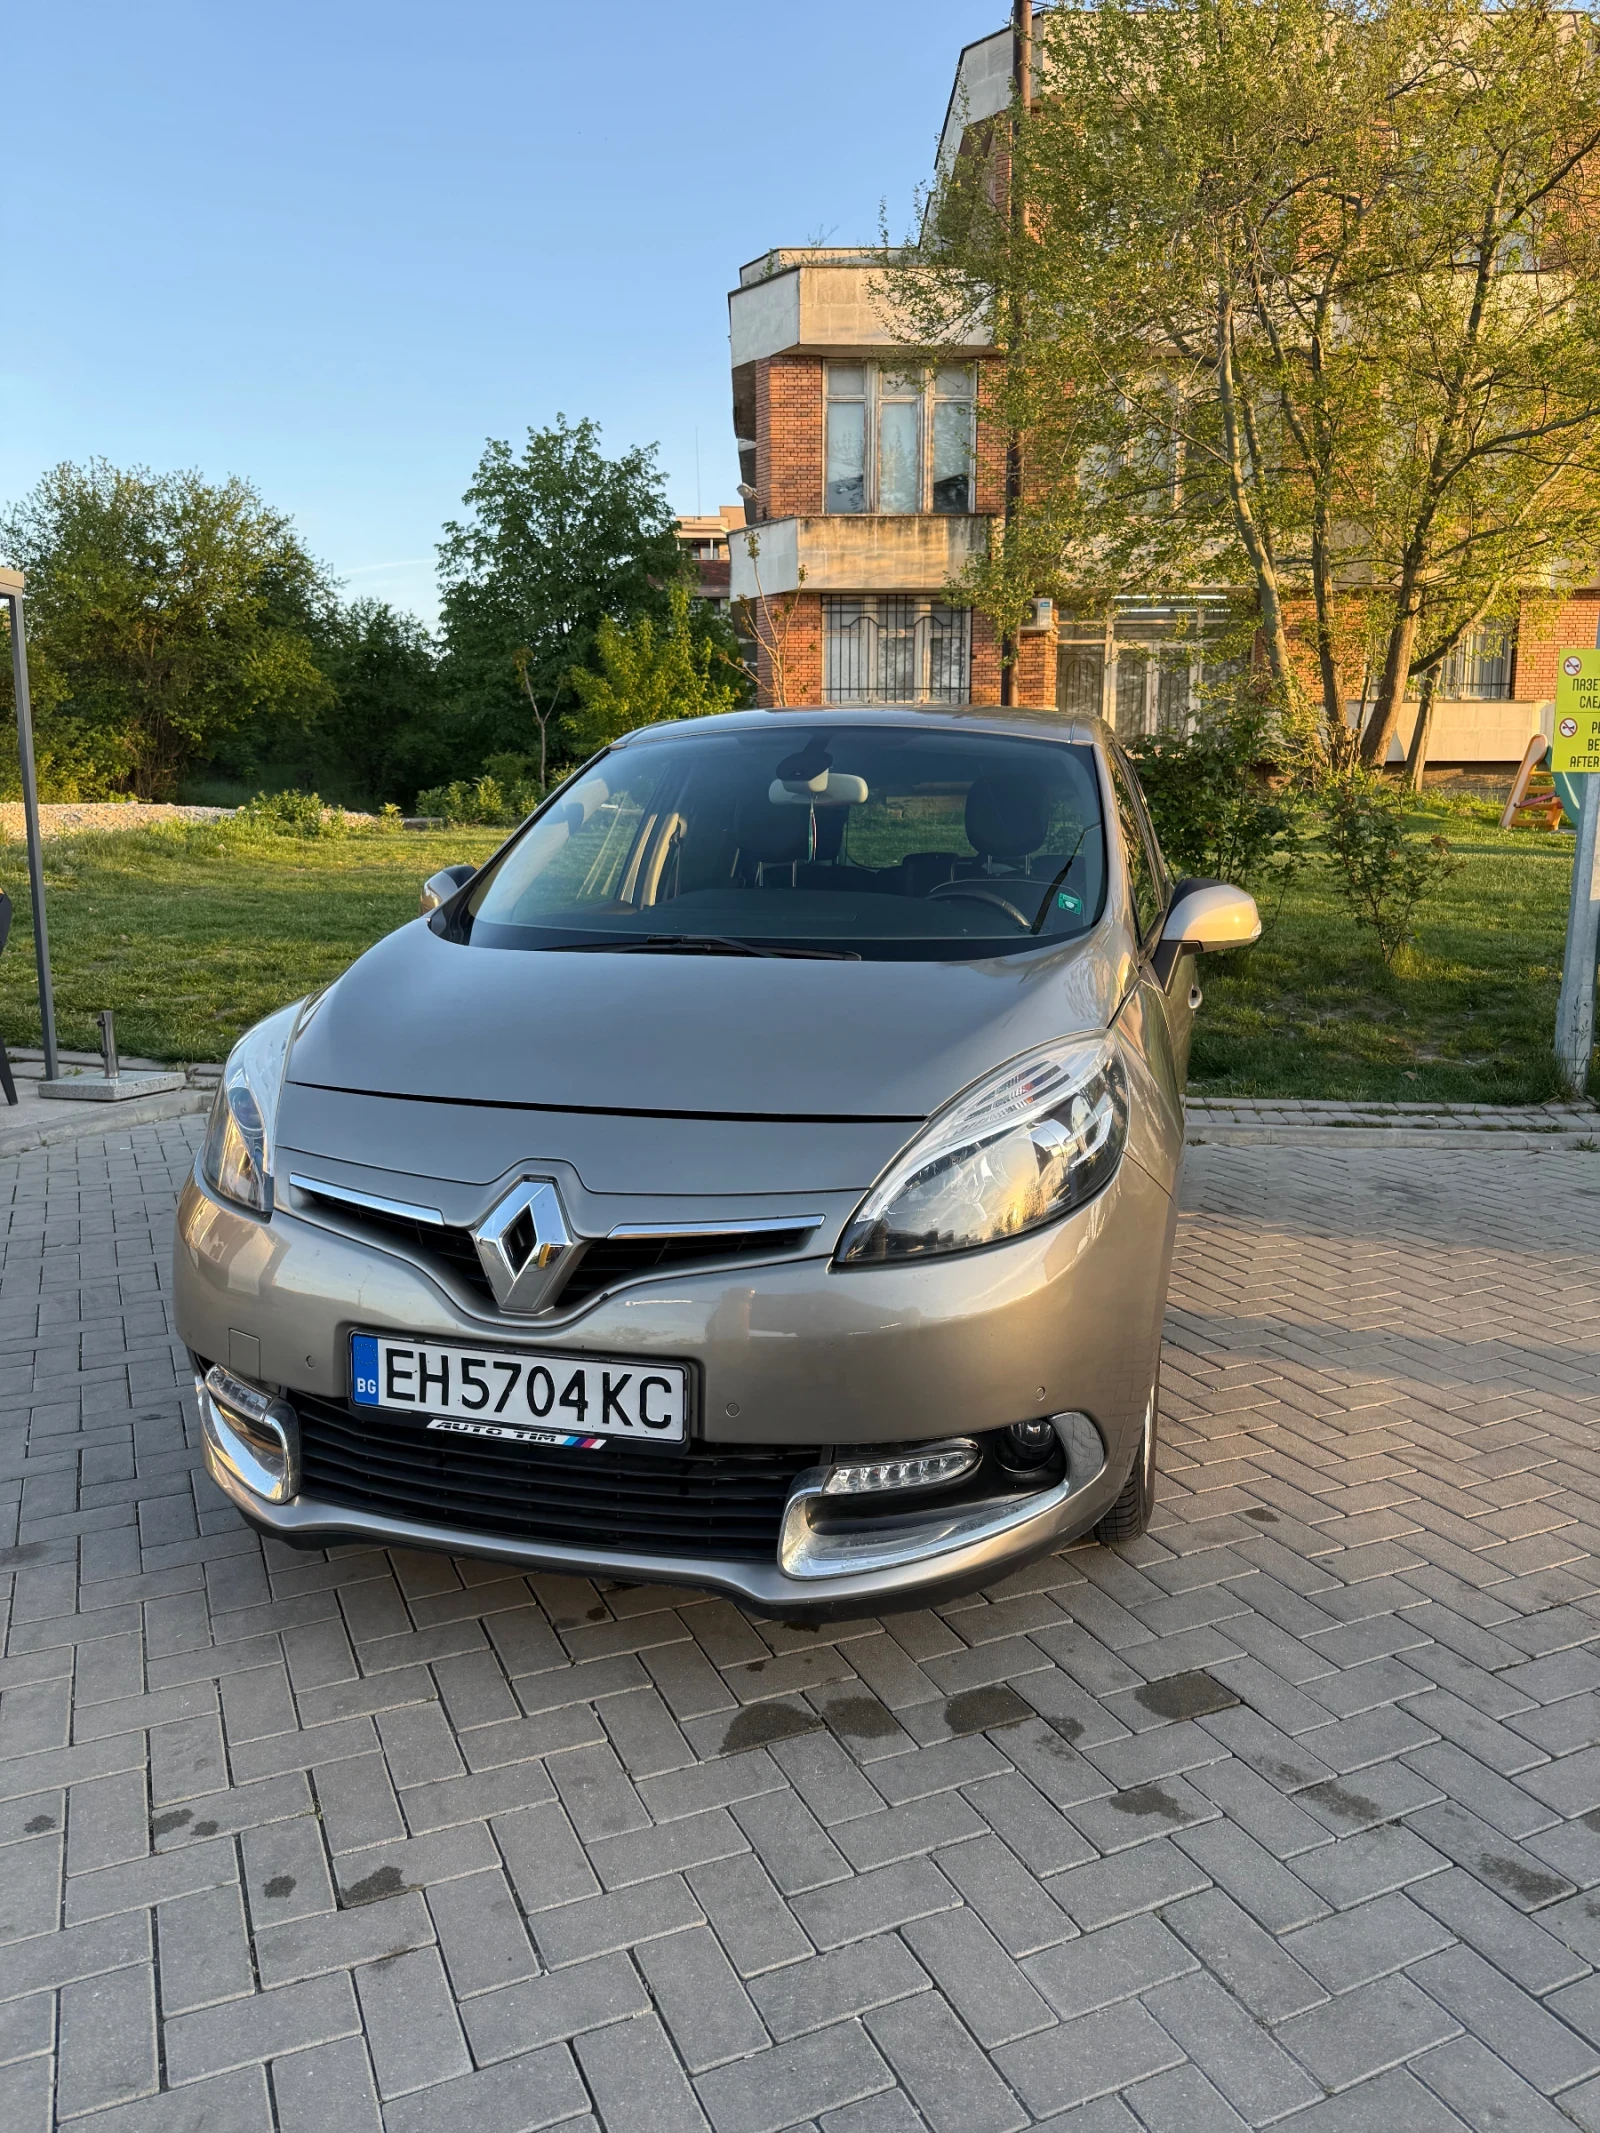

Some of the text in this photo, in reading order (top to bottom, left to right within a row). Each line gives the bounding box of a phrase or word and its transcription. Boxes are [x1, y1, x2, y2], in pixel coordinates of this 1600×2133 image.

[1572, 678, 1600, 691] ПАЗЕ
[1579, 695, 1600, 709] СЛЕ
[1569, 755, 1600, 768] AFTER
[356, 1377, 378, 1395] BG
[435, 1421, 557, 1443] AUTO TIM
